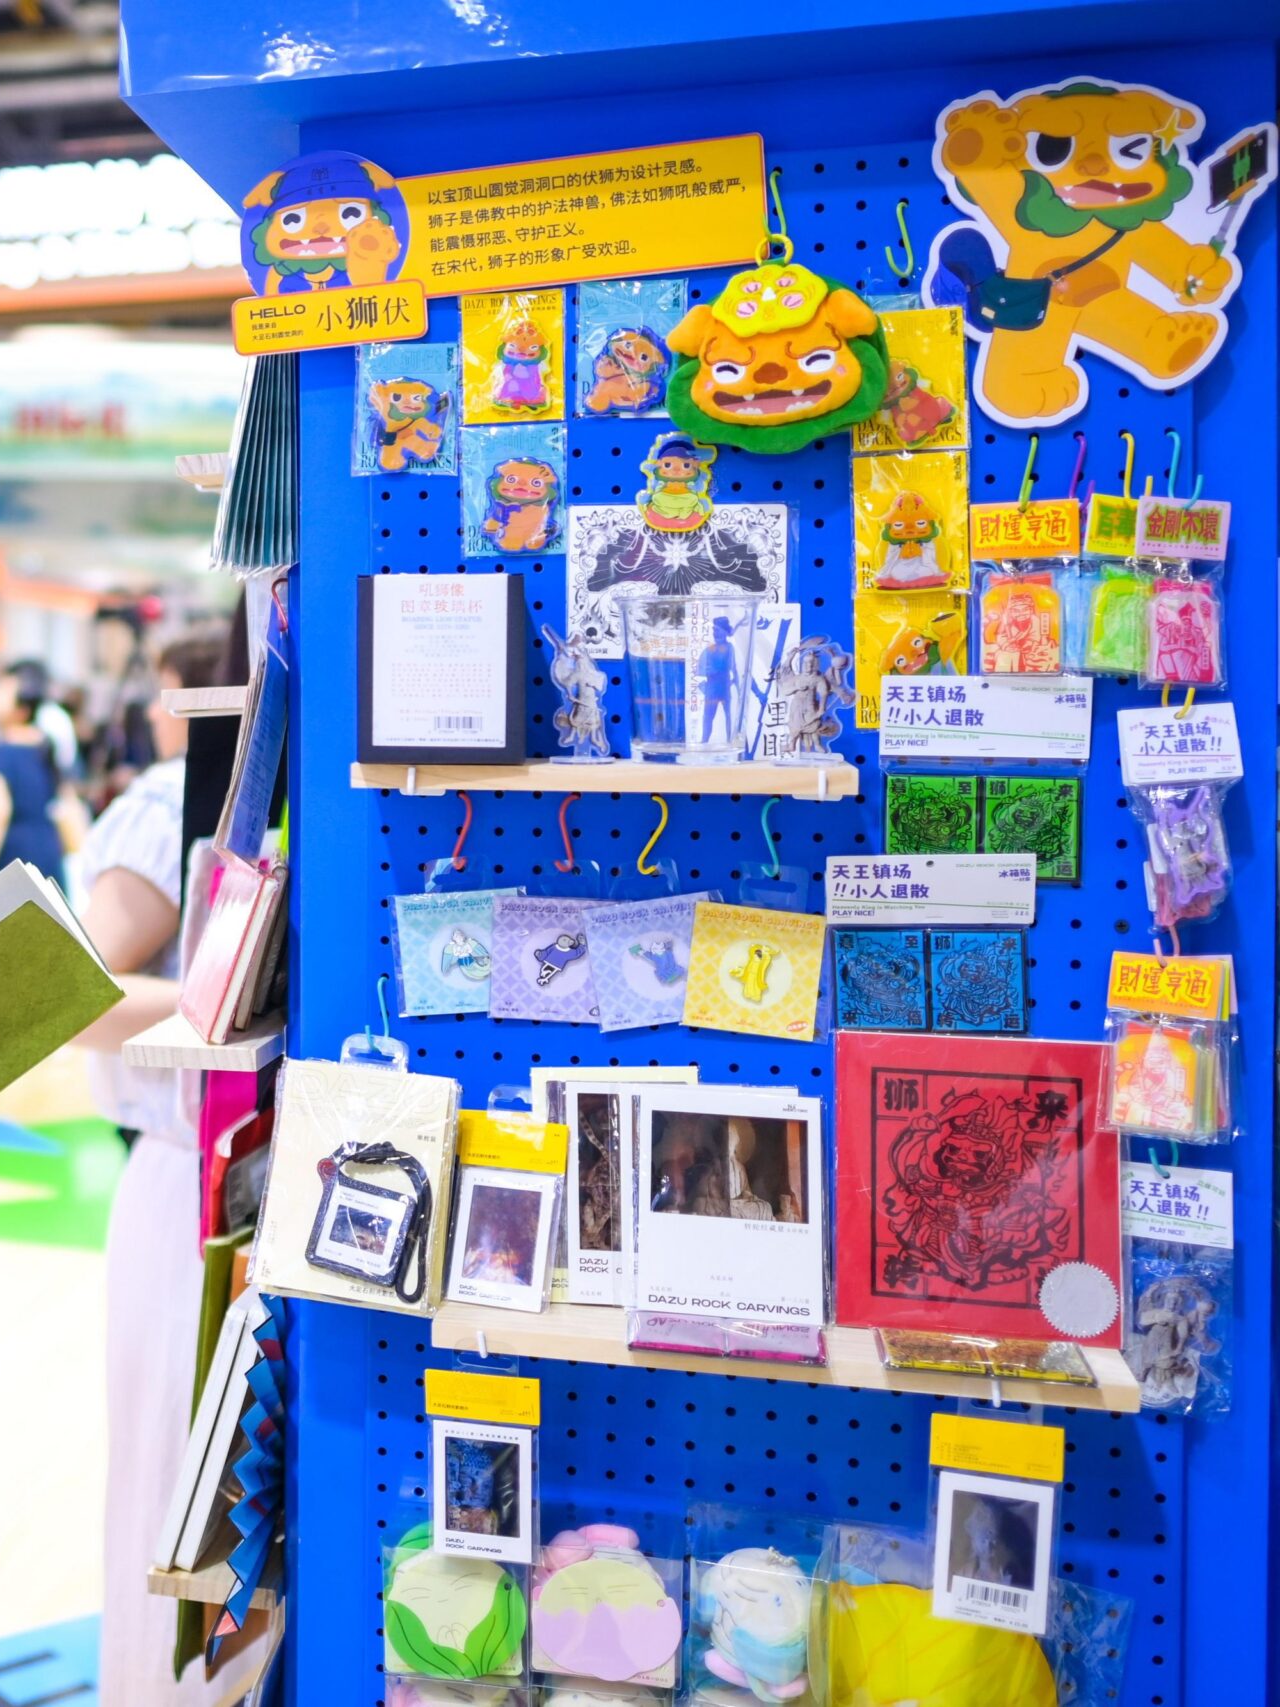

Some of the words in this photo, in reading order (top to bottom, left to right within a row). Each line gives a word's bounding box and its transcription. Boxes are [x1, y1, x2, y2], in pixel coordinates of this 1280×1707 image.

[428, 159, 703, 204] 以宝顶山圆觉洞洞口的伏狮为设计灵感。
[430, 222, 585, 252] 能震慑邪恶、守护正义。
[250, 304, 306, 320] HELLO
[316, 295, 410, 332] 小狮伏
[979, 509, 1068, 544] 財運亨通
[1147, 504, 1218, 544] 金剛不壞
[886, 685, 967, 703] 天王镇场
[1144, 721, 1212, 739] 天王镇场
[907, 739, 929, 747] NICE!
[832, 863, 912, 880] 天王镇场
[1117, 964, 1208, 1003] 財運亨通
[884, 1078, 919, 1112] 狮
[1130, 1179, 1201, 1202] 天王镇场
[579, 1257, 609, 1266] DAZU
[579, 1266, 610, 1274] ROCK
[648, 1294, 688, 1306] DAZU
[691, 1298, 732, 1310] ROCK
[736, 1302, 811, 1317] CARVINGS
[467, 1546, 503, 1554] CARVINGS
